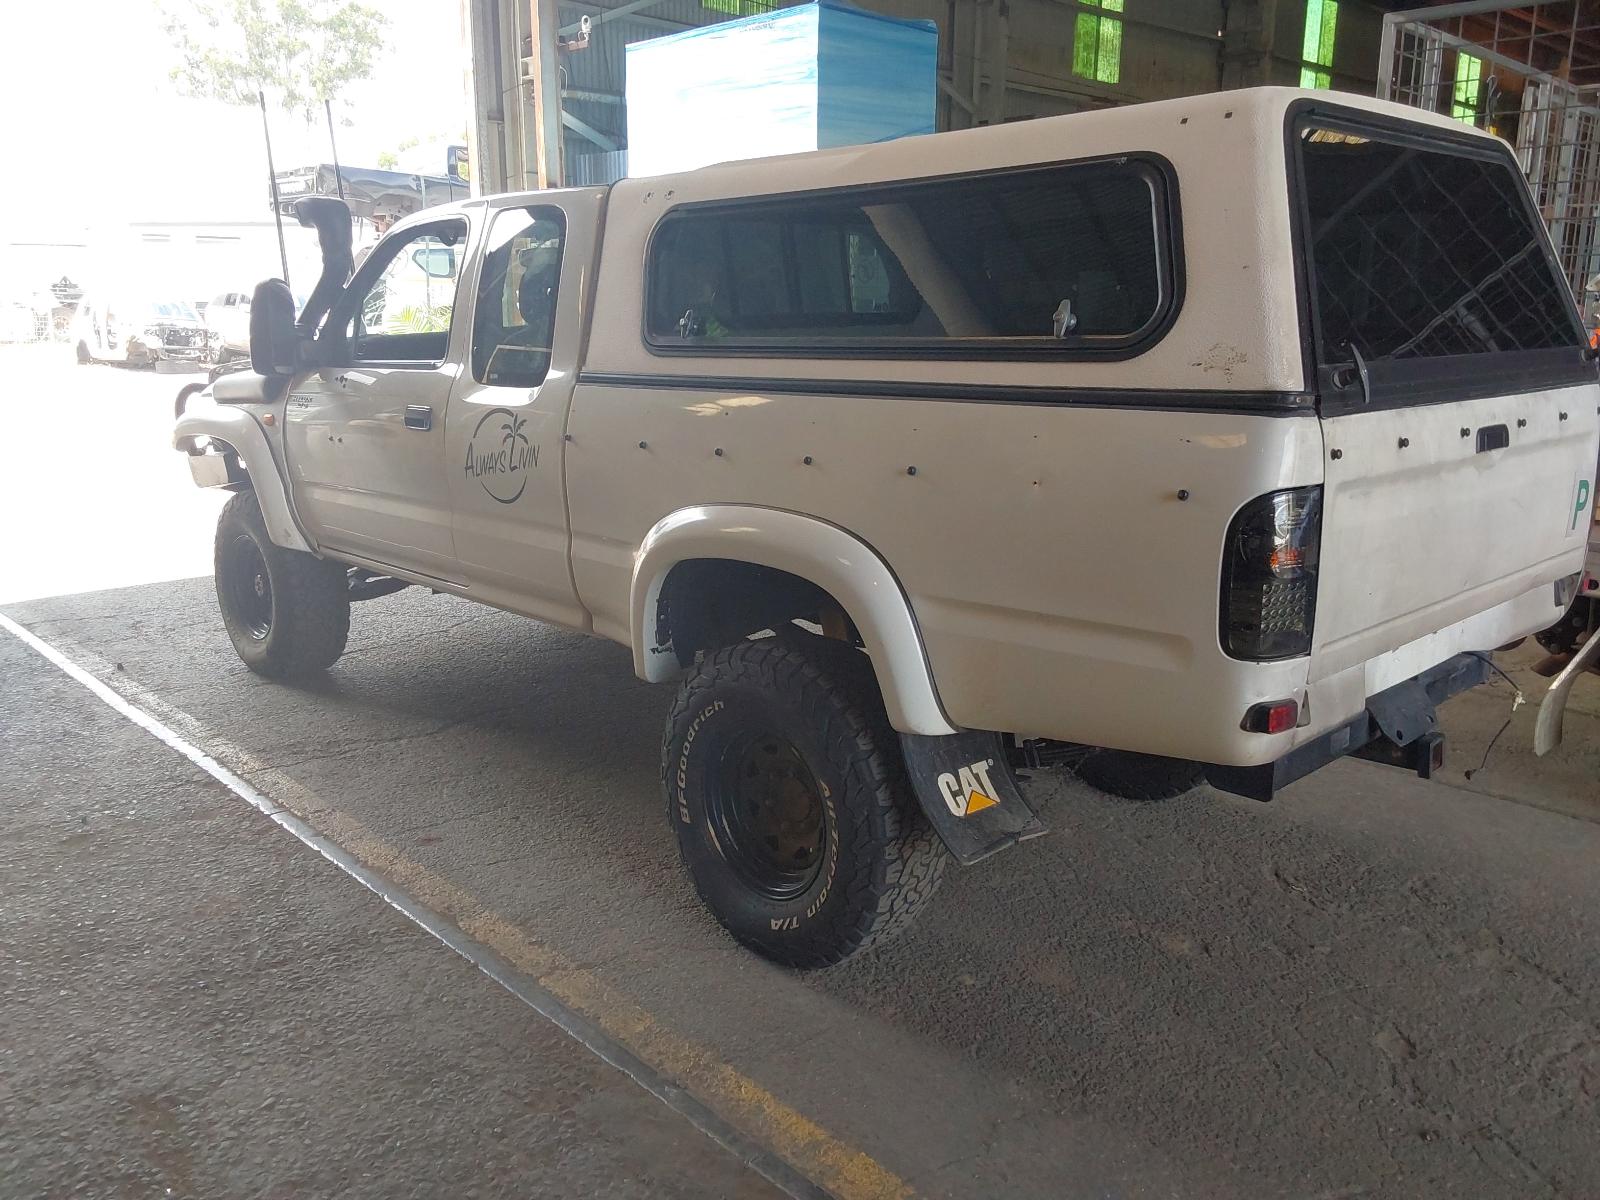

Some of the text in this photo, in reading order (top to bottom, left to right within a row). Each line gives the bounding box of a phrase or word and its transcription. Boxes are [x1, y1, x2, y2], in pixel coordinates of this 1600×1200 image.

[464, 441, 506, 479] ALWAYS
[1572, 479, 1589, 530] P
[677, 700, 725, 824] BFGoodrich
[938, 759, 1000, 817] CAT
[770, 915, 800, 931] T/A
